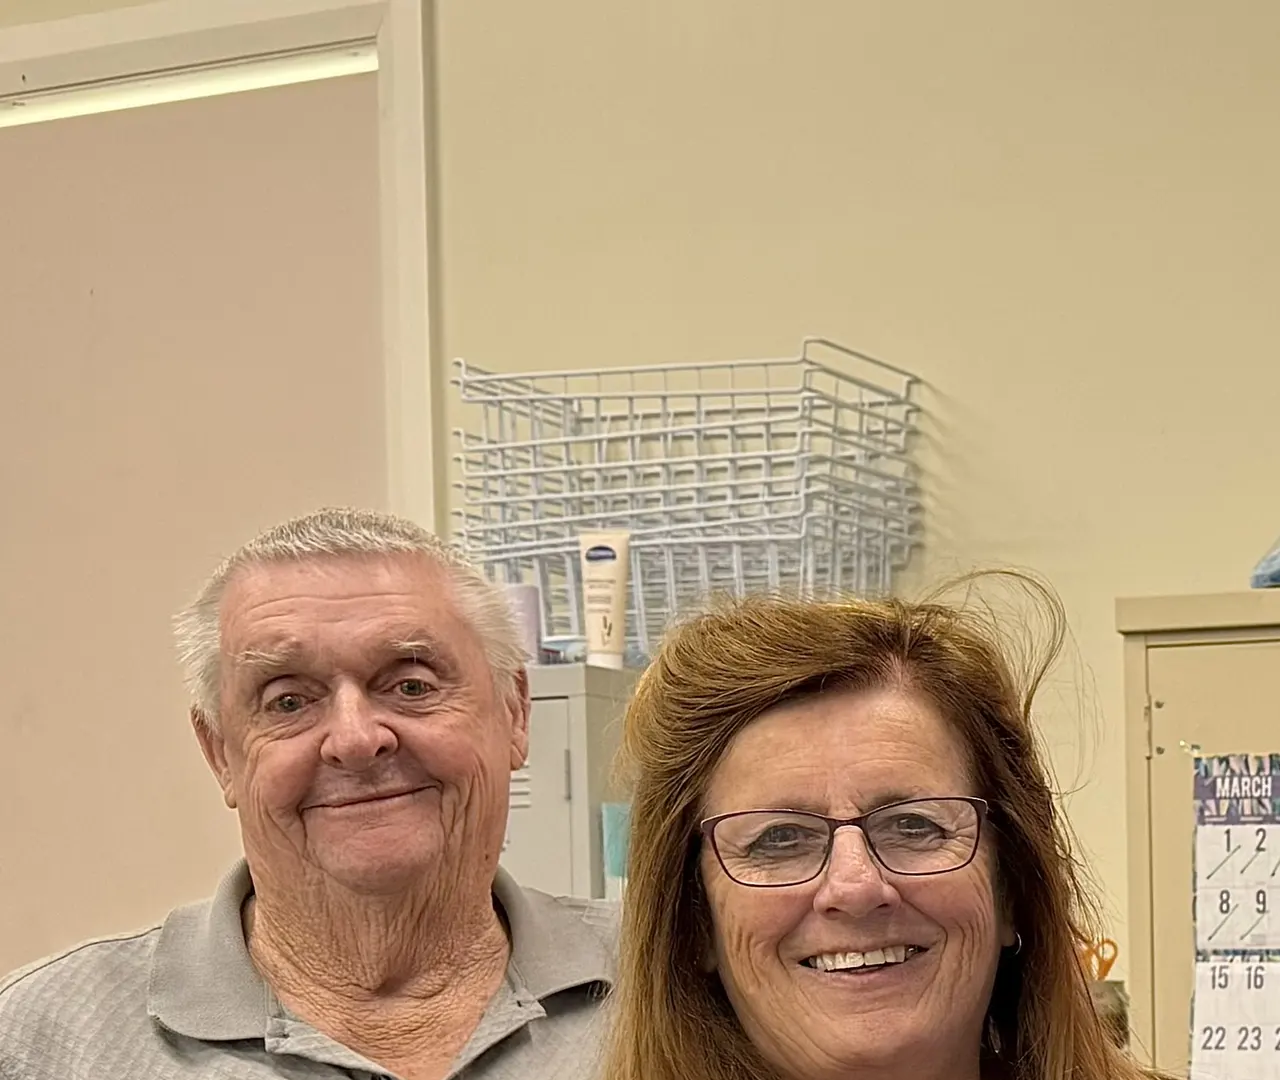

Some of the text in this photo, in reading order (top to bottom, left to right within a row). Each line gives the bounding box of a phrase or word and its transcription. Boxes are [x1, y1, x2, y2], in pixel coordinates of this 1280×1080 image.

[1215, 776, 1271, 798] MARCH
[1224, 828, 1231, 852] 1
[1255, 828, 1266, 851] 2
[1219, 890, 1230, 914] 8
[1256, 890, 1266, 914] 9
[1211, 966, 1228, 989] 15
[1246, 966, 1264, 989] 16
[1202, 1026, 1226, 1050] 22
[1237, 1026, 1261, 1050] 23
